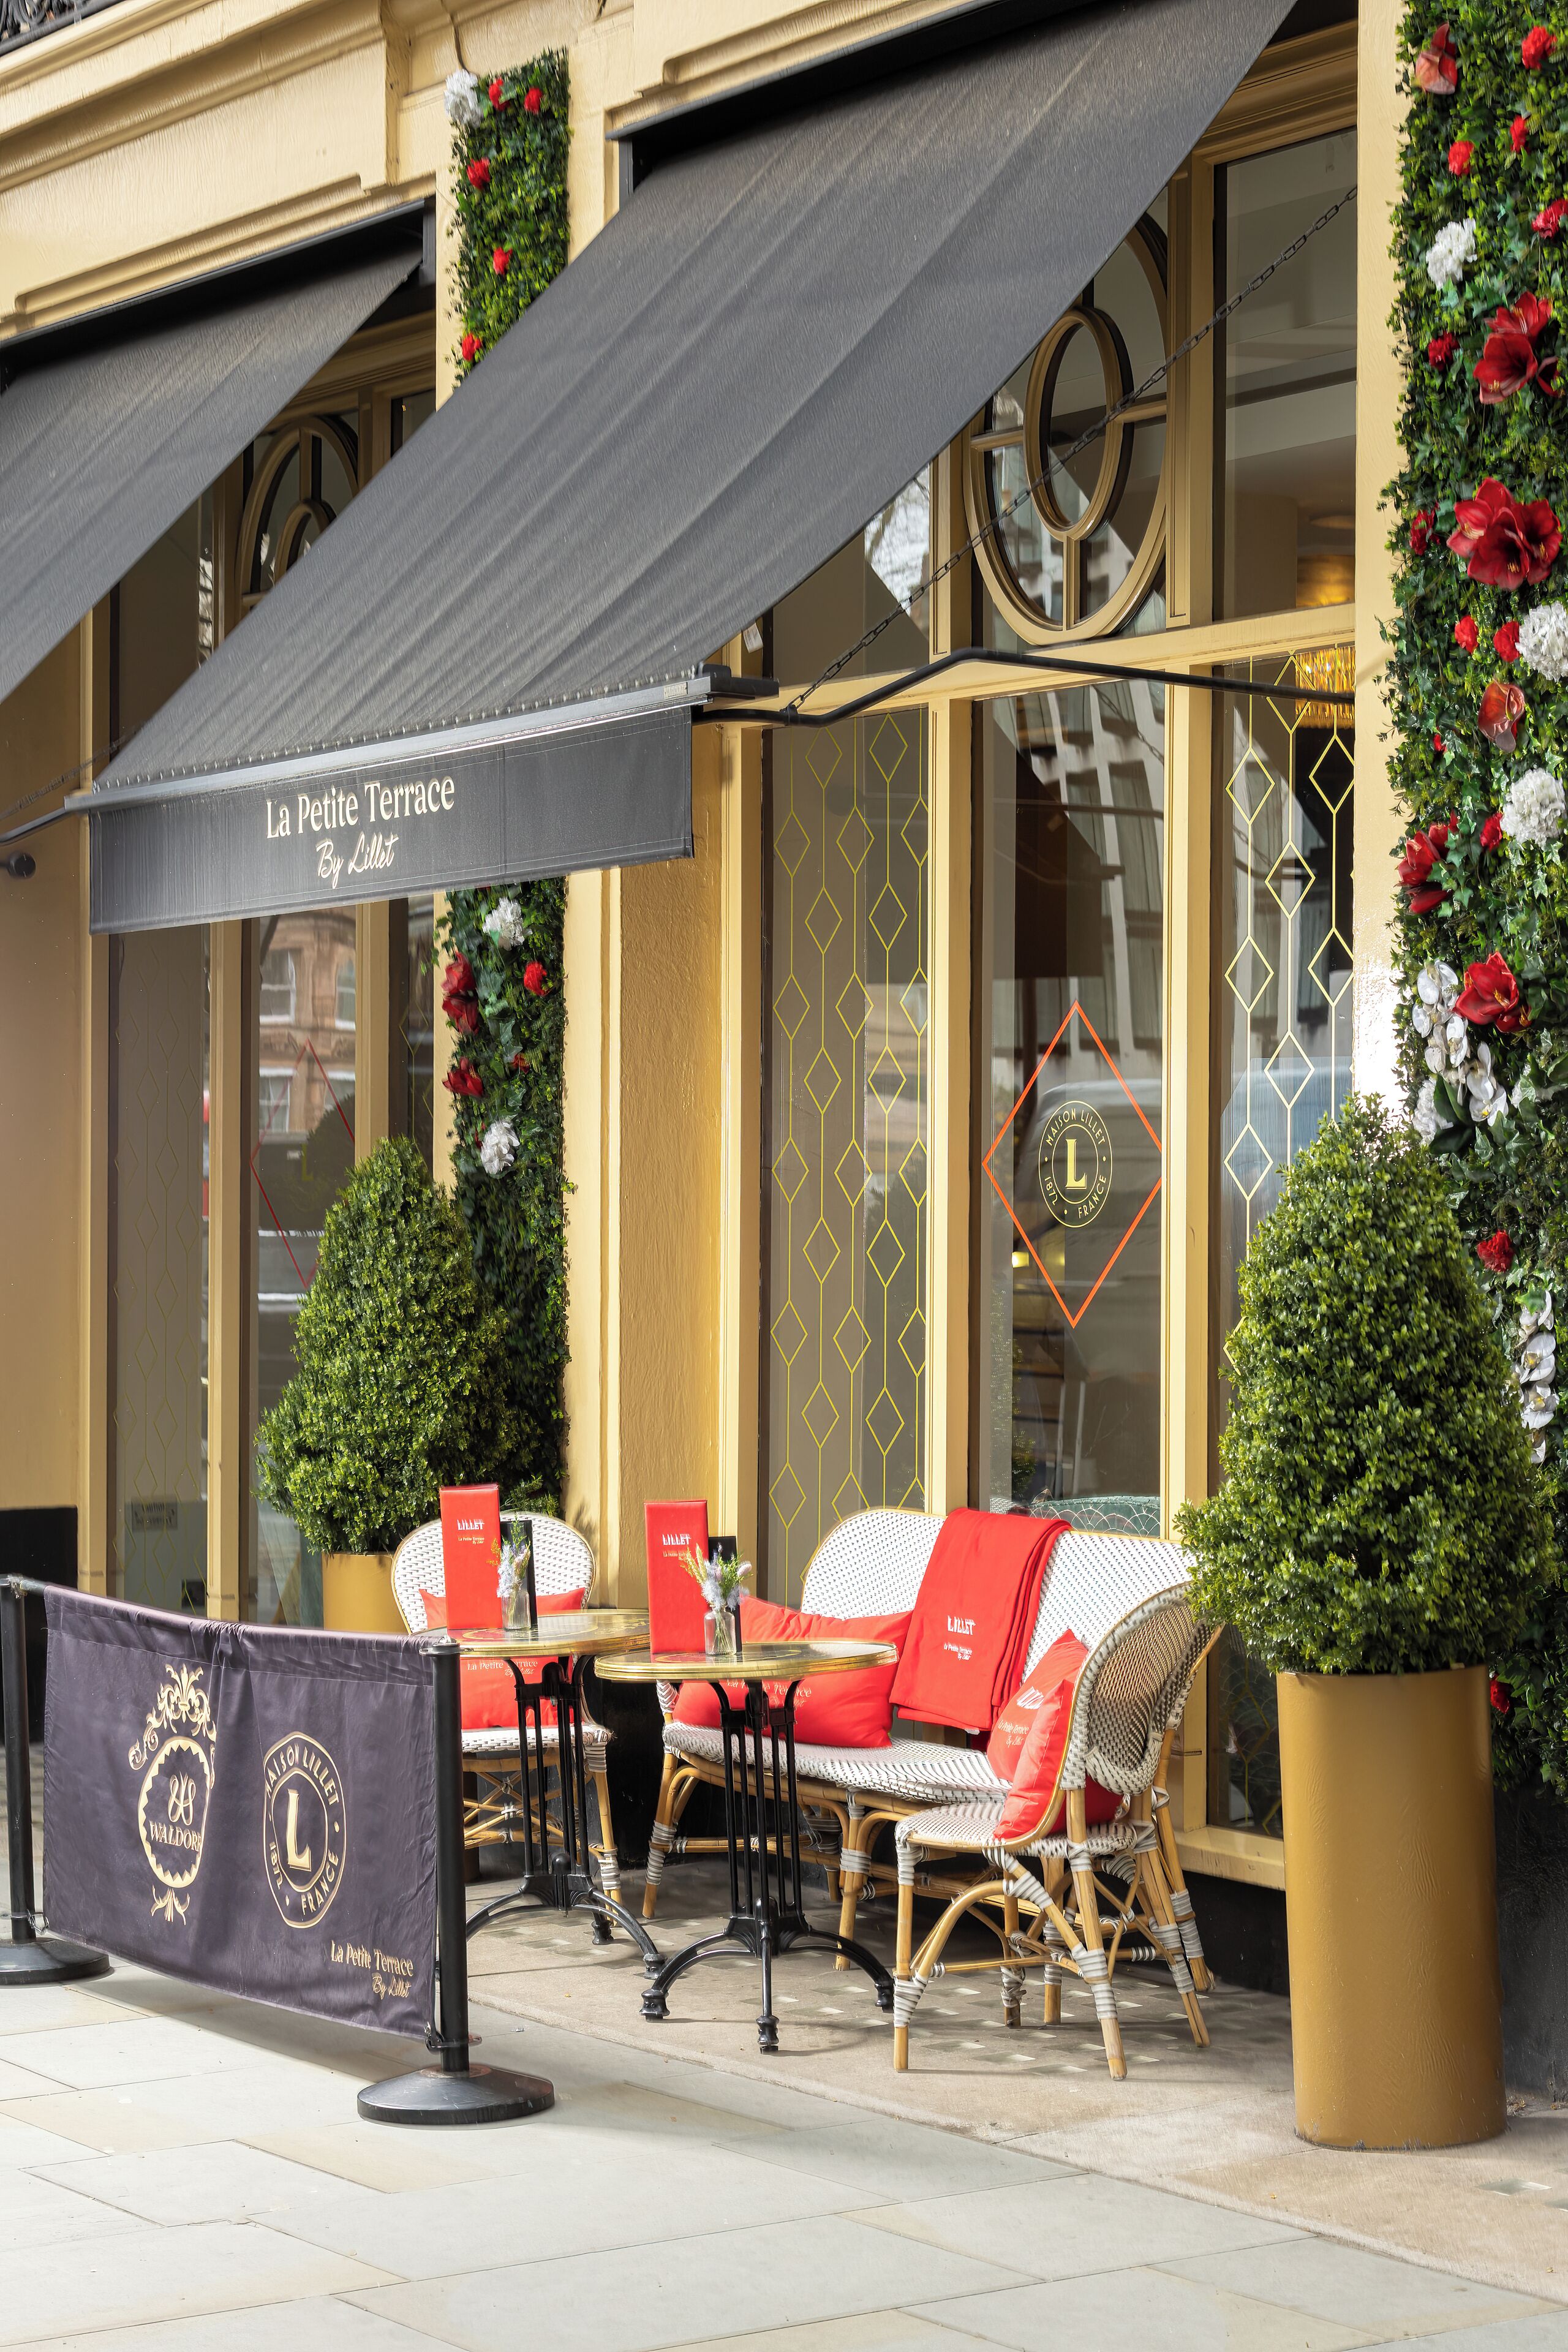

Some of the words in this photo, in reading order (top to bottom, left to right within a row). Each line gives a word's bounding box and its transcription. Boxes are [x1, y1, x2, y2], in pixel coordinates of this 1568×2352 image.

[267, 799, 291, 839] La
[298, 786, 359, 834] Petite
[364, 777, 455, 822] Terrace
[316, 839, 344, 889] By
[348, 832, 399, 875] Lillet
[1046, 1108, 1076, 1146] MAISON
[1080, 1109, 1106, 1145] LILLET
[1065, 1139, 1087, 1189] L
[1044, 1176, 1059, 1205] 1872
[1078, 1175, 1107, 1219] FRANCE
[457, 1519, 485, 1531] LILLET
[662, 1534, 691, 1545] LILLET
[948, 1615, 976, 1635] LILLET
[480, 1661, 503, 1670] Petite
[504, 1668, 514, 1678] By
[303, 1747, 339, 1805] LILLET
[286, 1789, 312, 1872] L
[301, 1849, 339, 1915] FRANCE
[331, 1940, 343, 1963] La
[346, 1943, 371, 1969] Petite
[374, 1948, 413, 1977] Terrace
[372, 1973, 387, 2000] By
[388, 1975, 412, 1998] Lillet
